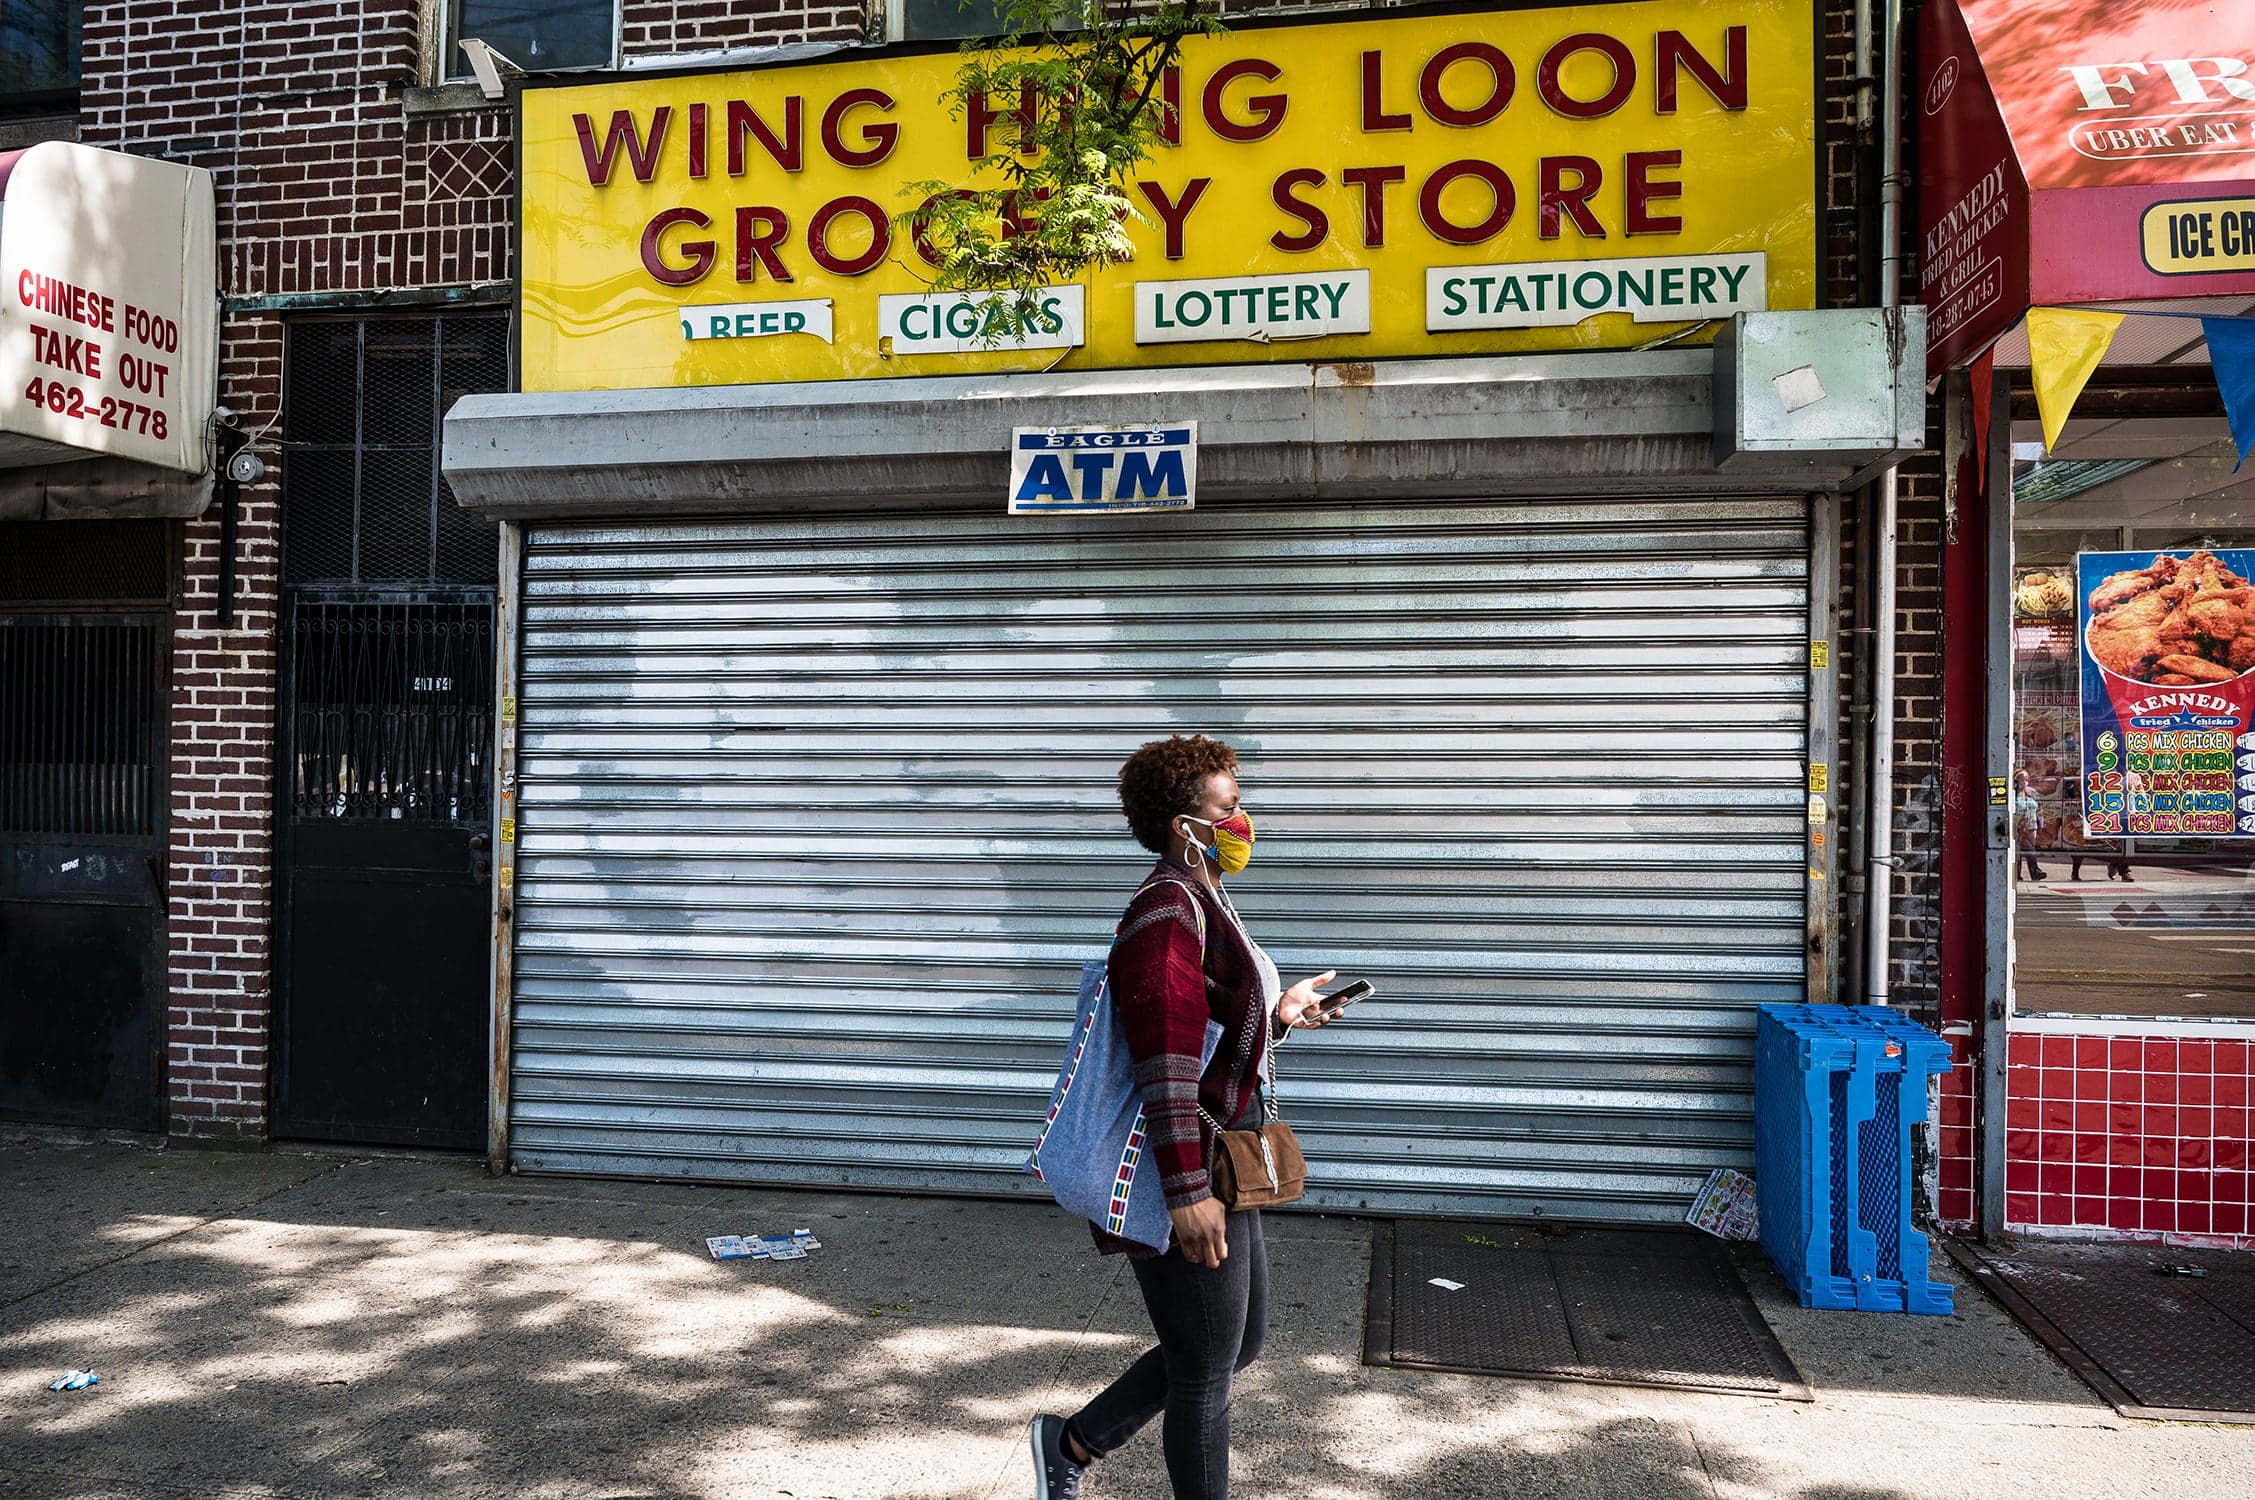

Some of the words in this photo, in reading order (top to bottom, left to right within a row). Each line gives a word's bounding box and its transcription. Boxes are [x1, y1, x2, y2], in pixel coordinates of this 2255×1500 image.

[571, 87, 900, 187] WING
[1361, 24, 1748, 132] LOON
[2084, 127, 2175, 151] UBER
[2178, 123, 2239, 145] EAT
[1269, 149, 1683, 253] STORE
[1926, 158, 2007, 262] KENNEDY
[1922, 247, 1953, 291] FRIED
[1956, 194, 2009, 258] CHICKEN
[2168, 213, 2215, 259] ICE
[1442, 264, 1751, 316] STATIONERY
[1939, 276, 1949, 298] &
[1951, 245, 1985, 288] GRILL
[18, 269, 114, 333] CHINESE
[124, 303, 178, 354] FOOD
[1154, 281, 1351, 328] LOTTERY
[30, 324, 101, 379] TAKE
[119, 353, 169, 398] OUT
[25, 377, 168, 440] 462-2778
[1045, 433, 1165, 448] EAGLE
[1015, 450, 1188, 500] ATM
[2129, 693, 2240, 716] KENNEDY
[2140, 718, 2171, 726] fried
[2196, 718, 2233, 726] chicken
[2098, 732, 2117, 750] 6
[2127, 732, 2149, 750] PCS
[2152, 732, 2177, 750] MIX
[2181, 732, 2232, 750] CHICKEN
[2098, 752, 2117, 771] 9
[2127, 753, 2150, 770] PCS
[2152, 753, 2178, 770] MIX
[2181, 753, 2233, 770] CHICKEN
[2089, 773, 2122, 791] 12
[2153, 773, 2178, 791] MIX
[2182, 773, 2233, 791] CHICKEN
[2090, 793, 2123, 811] 15
[2129, 793, 2150, 811] PCS
[2154, 793, 2178, 811] MIX
[2182, 793, 2233, 811] CHICKEN
[2089, 814, 2122, 831] 21
[2129, 814, 2151, 831] PCS
[2155, 814, 2179, 831] MIX
[2182, 814, 2234, 831] CHICKEN
